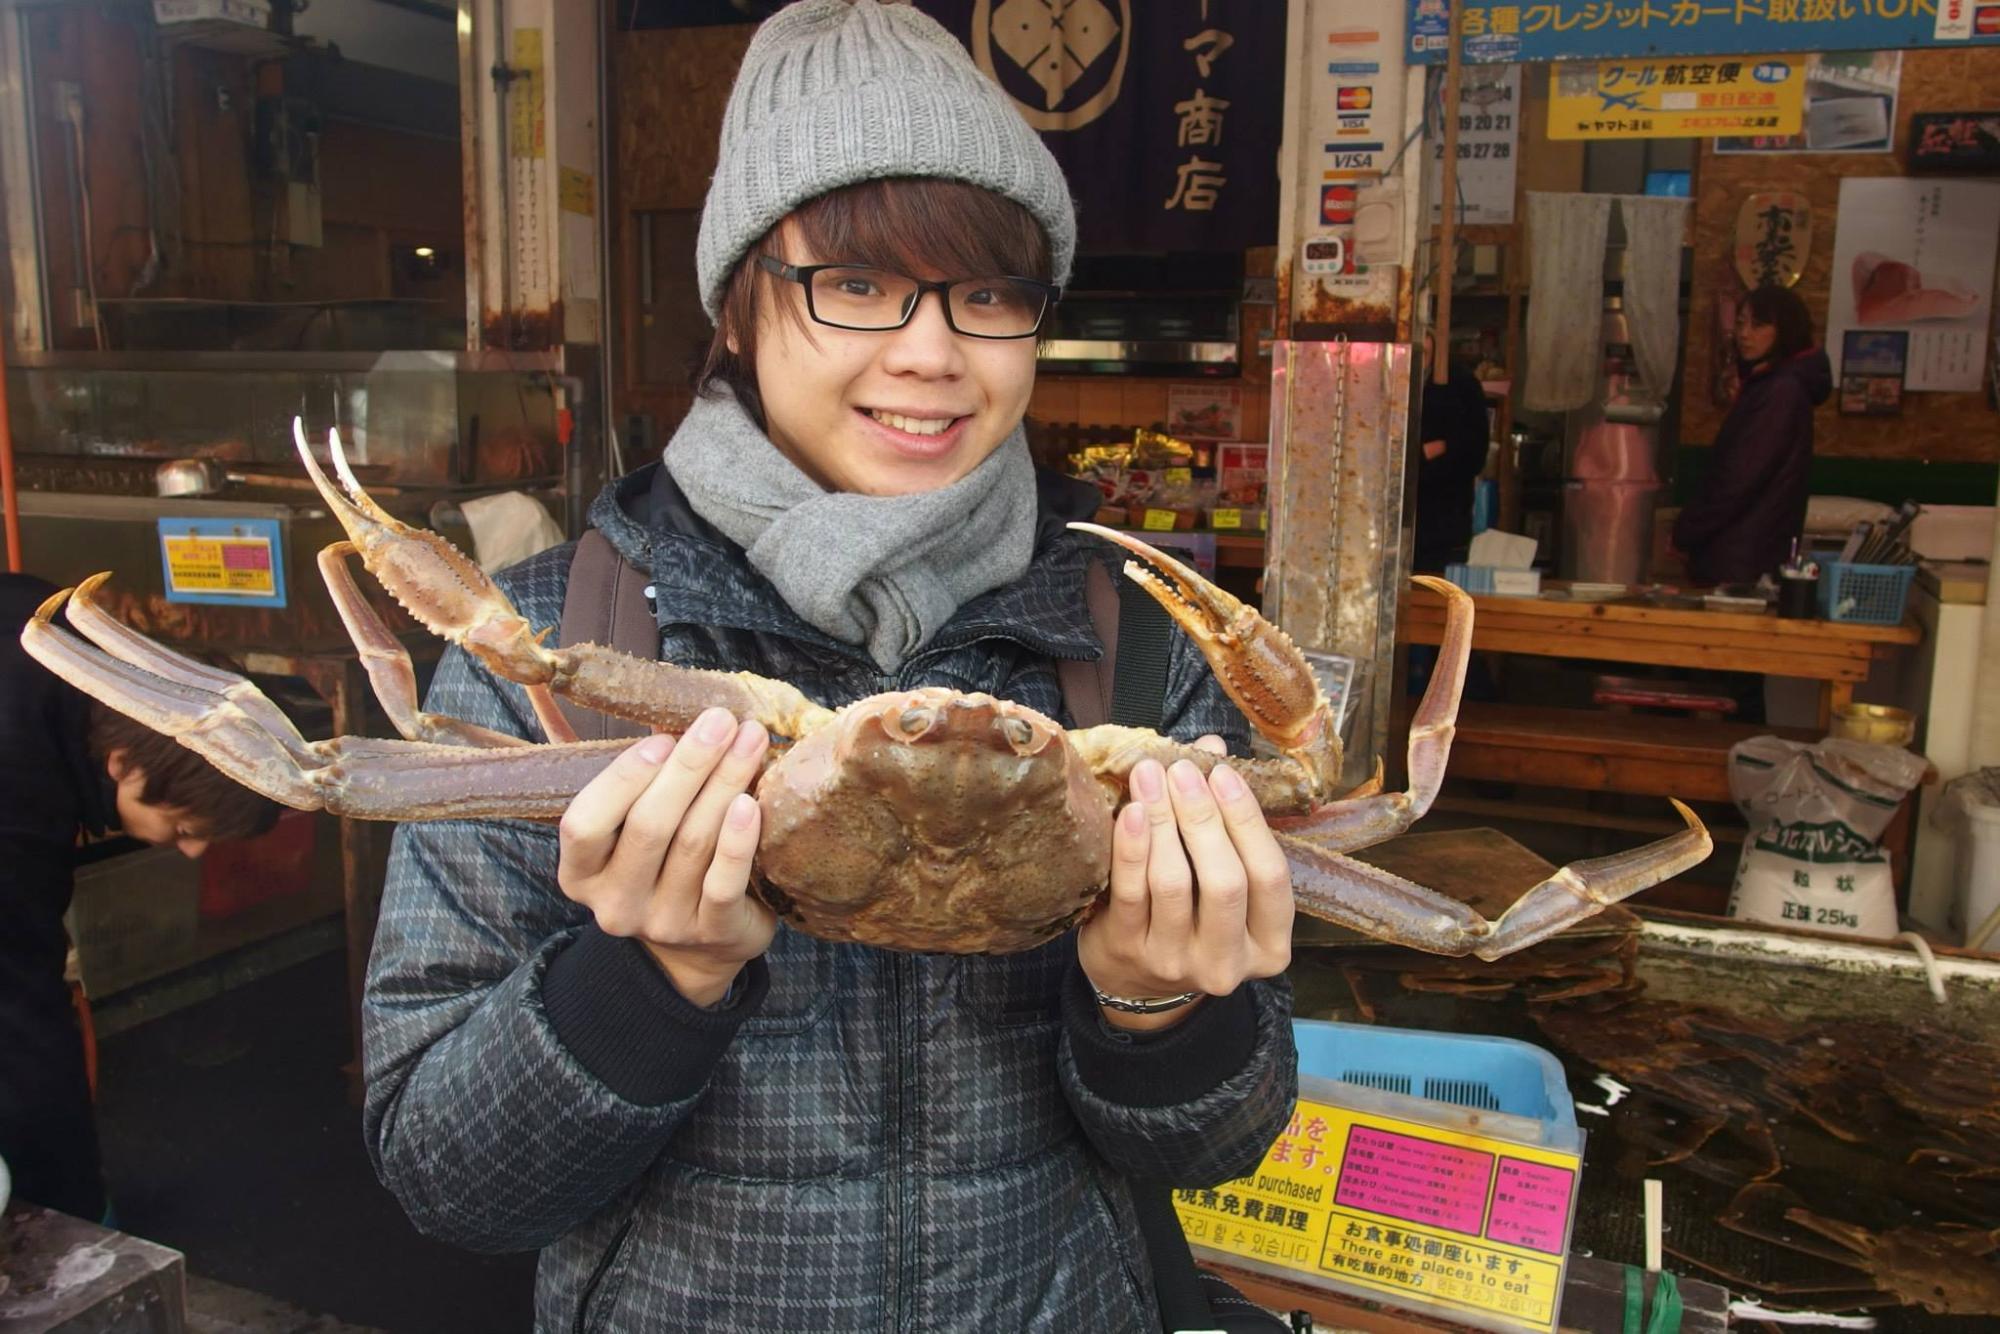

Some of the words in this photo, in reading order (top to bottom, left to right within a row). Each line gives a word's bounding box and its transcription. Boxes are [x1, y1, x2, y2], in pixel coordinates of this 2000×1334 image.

[1343, 120, 1365, 128] VISA
[1475, 115, 1492, 131] 20
[1496, 115, 1511, 131] 21
[1473, 143, 1491, 159] 27
[1493, 143, 1510, 159] 28
[1335, 153, 1372, 168] VISA
[1781, 901, 1812, 920] 正味
[1817, 907, 1858, 928] 25kg
[1257, 1174, 1324, 1204] purchased
[1341, 1237, 1384, 1260] There
[1390, 1252, 1415, 1267] are
[1421, 1260, 1474, 1282] places
[1481, 1272, 1497, 1287] to
[1503, 1280, 1530, 1295] eat
